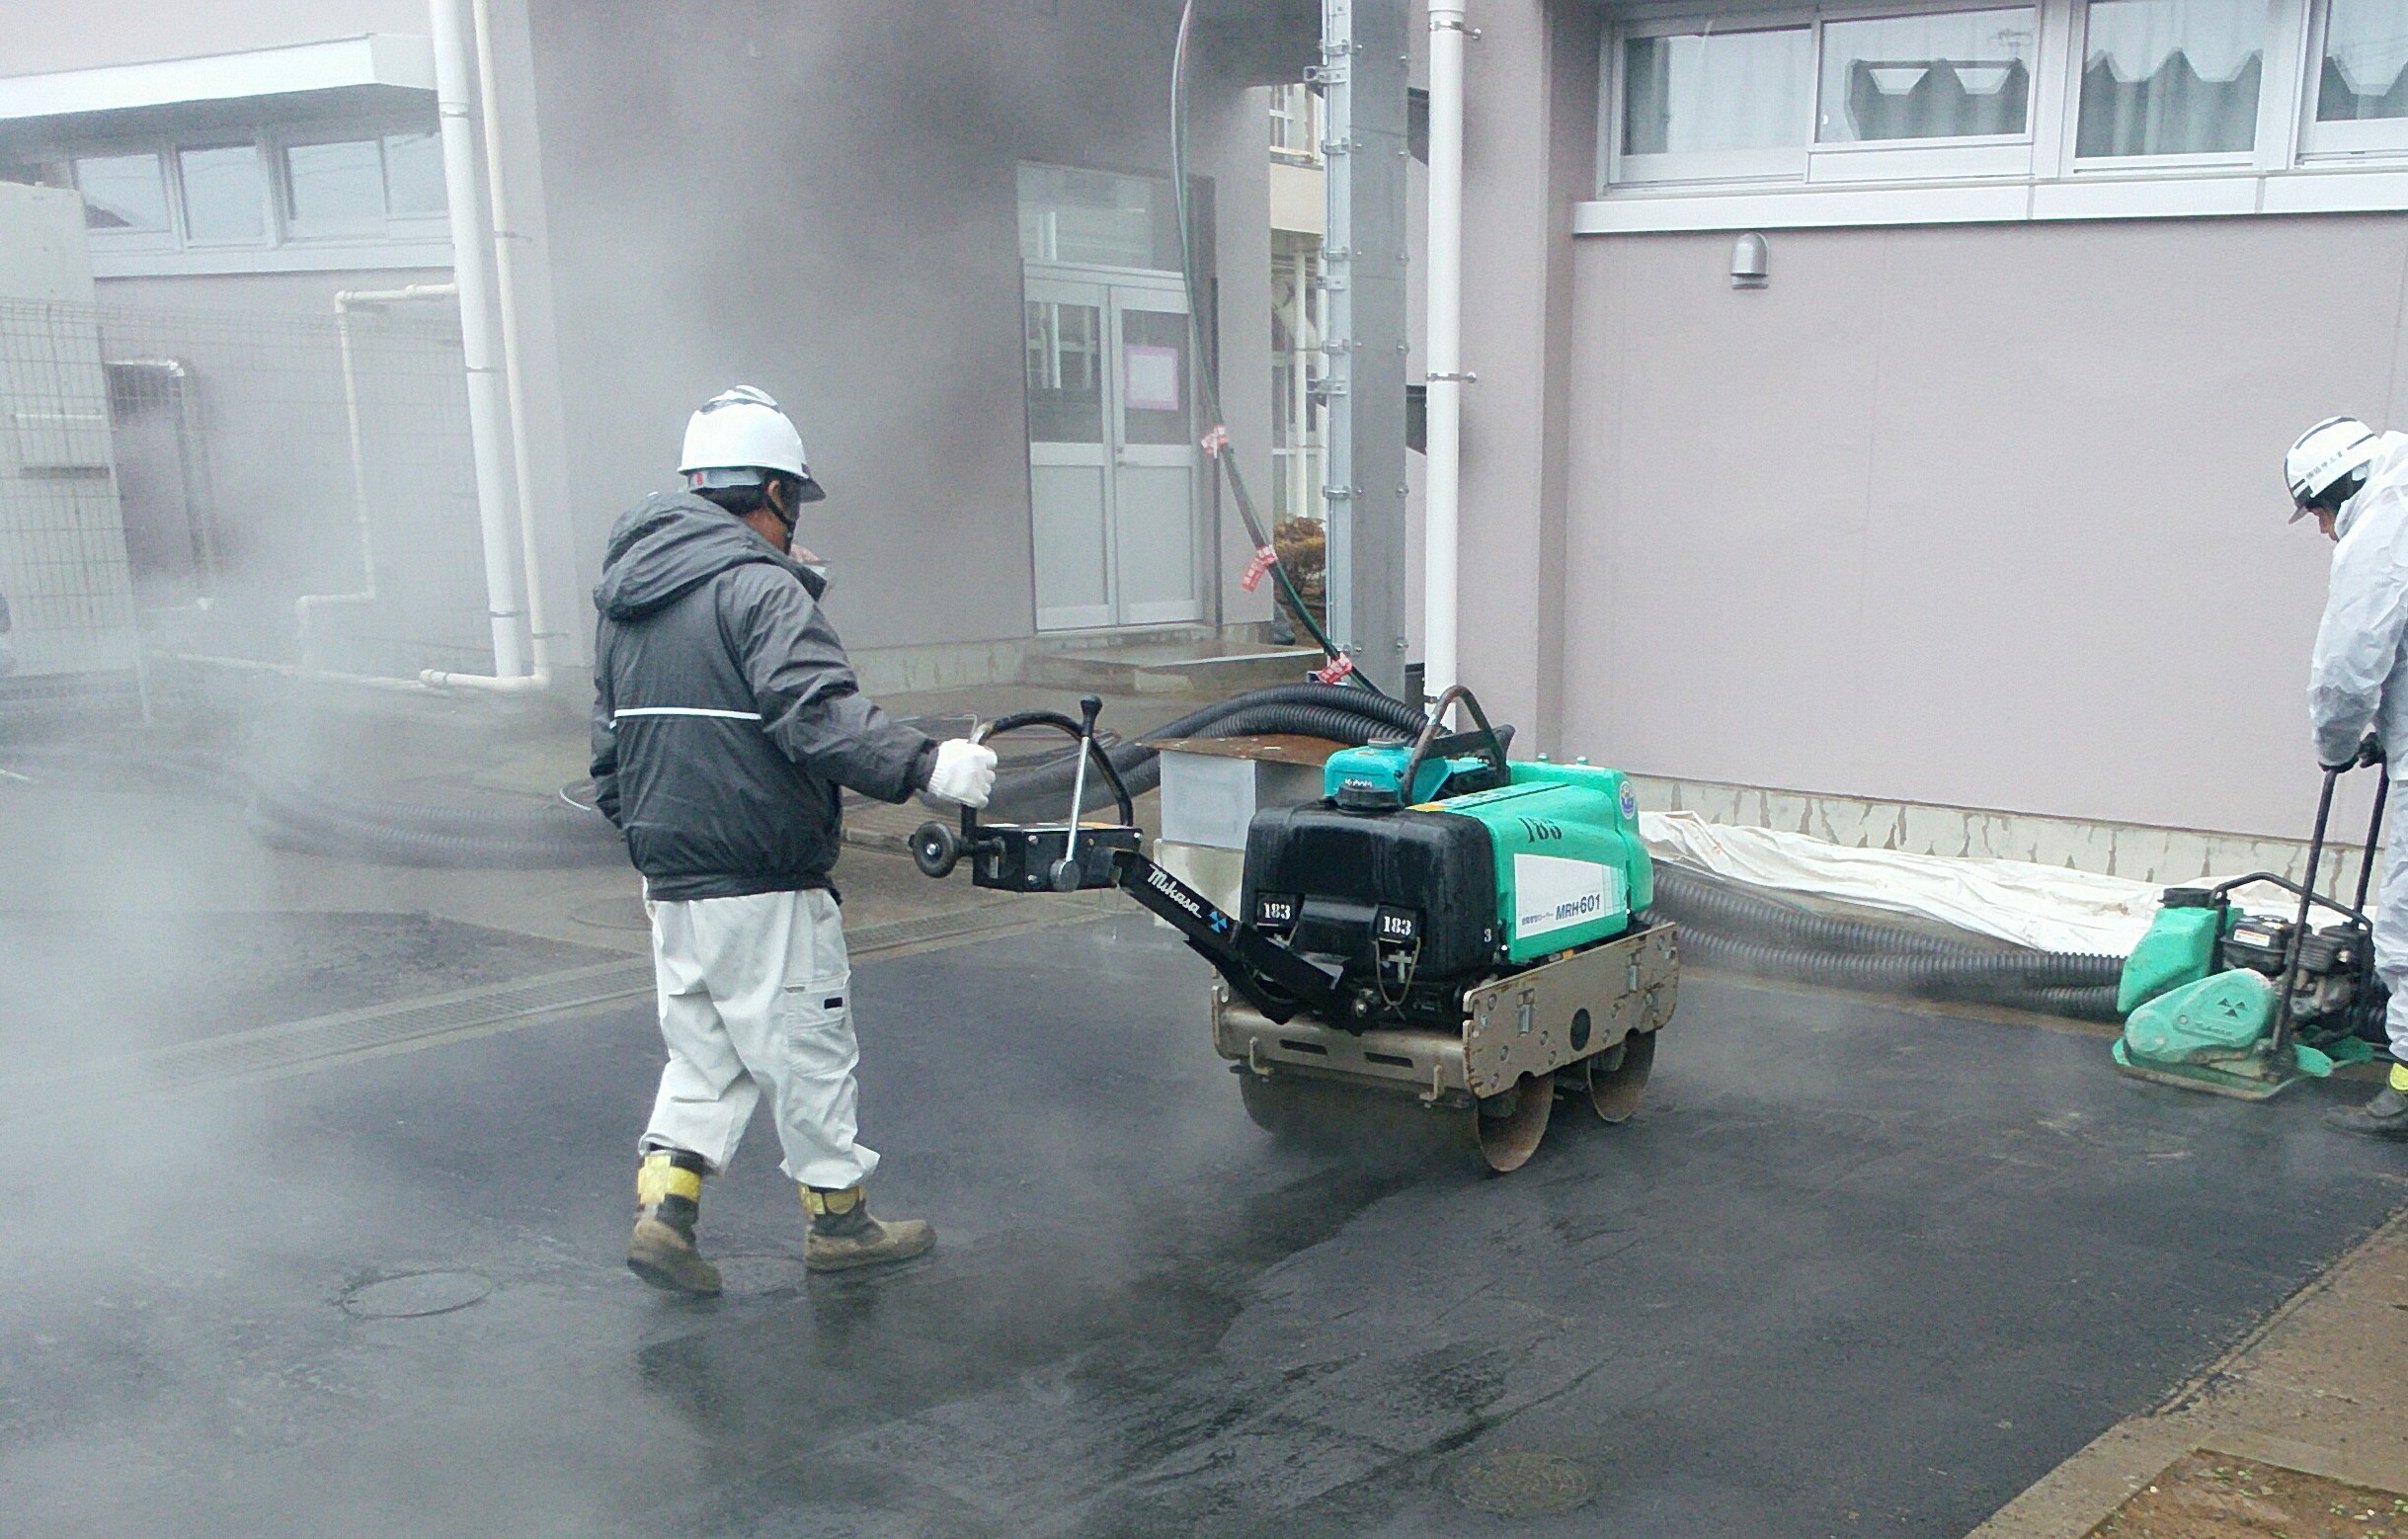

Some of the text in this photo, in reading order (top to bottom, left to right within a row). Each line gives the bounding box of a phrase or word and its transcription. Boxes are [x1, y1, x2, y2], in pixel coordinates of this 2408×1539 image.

[1147, 863, 1202, 919] Mikasa
[1263, 903, 1291, 920] 183
[1383, 916, 1411, 935] 183
[1484, 928, 1492, 942] 3
